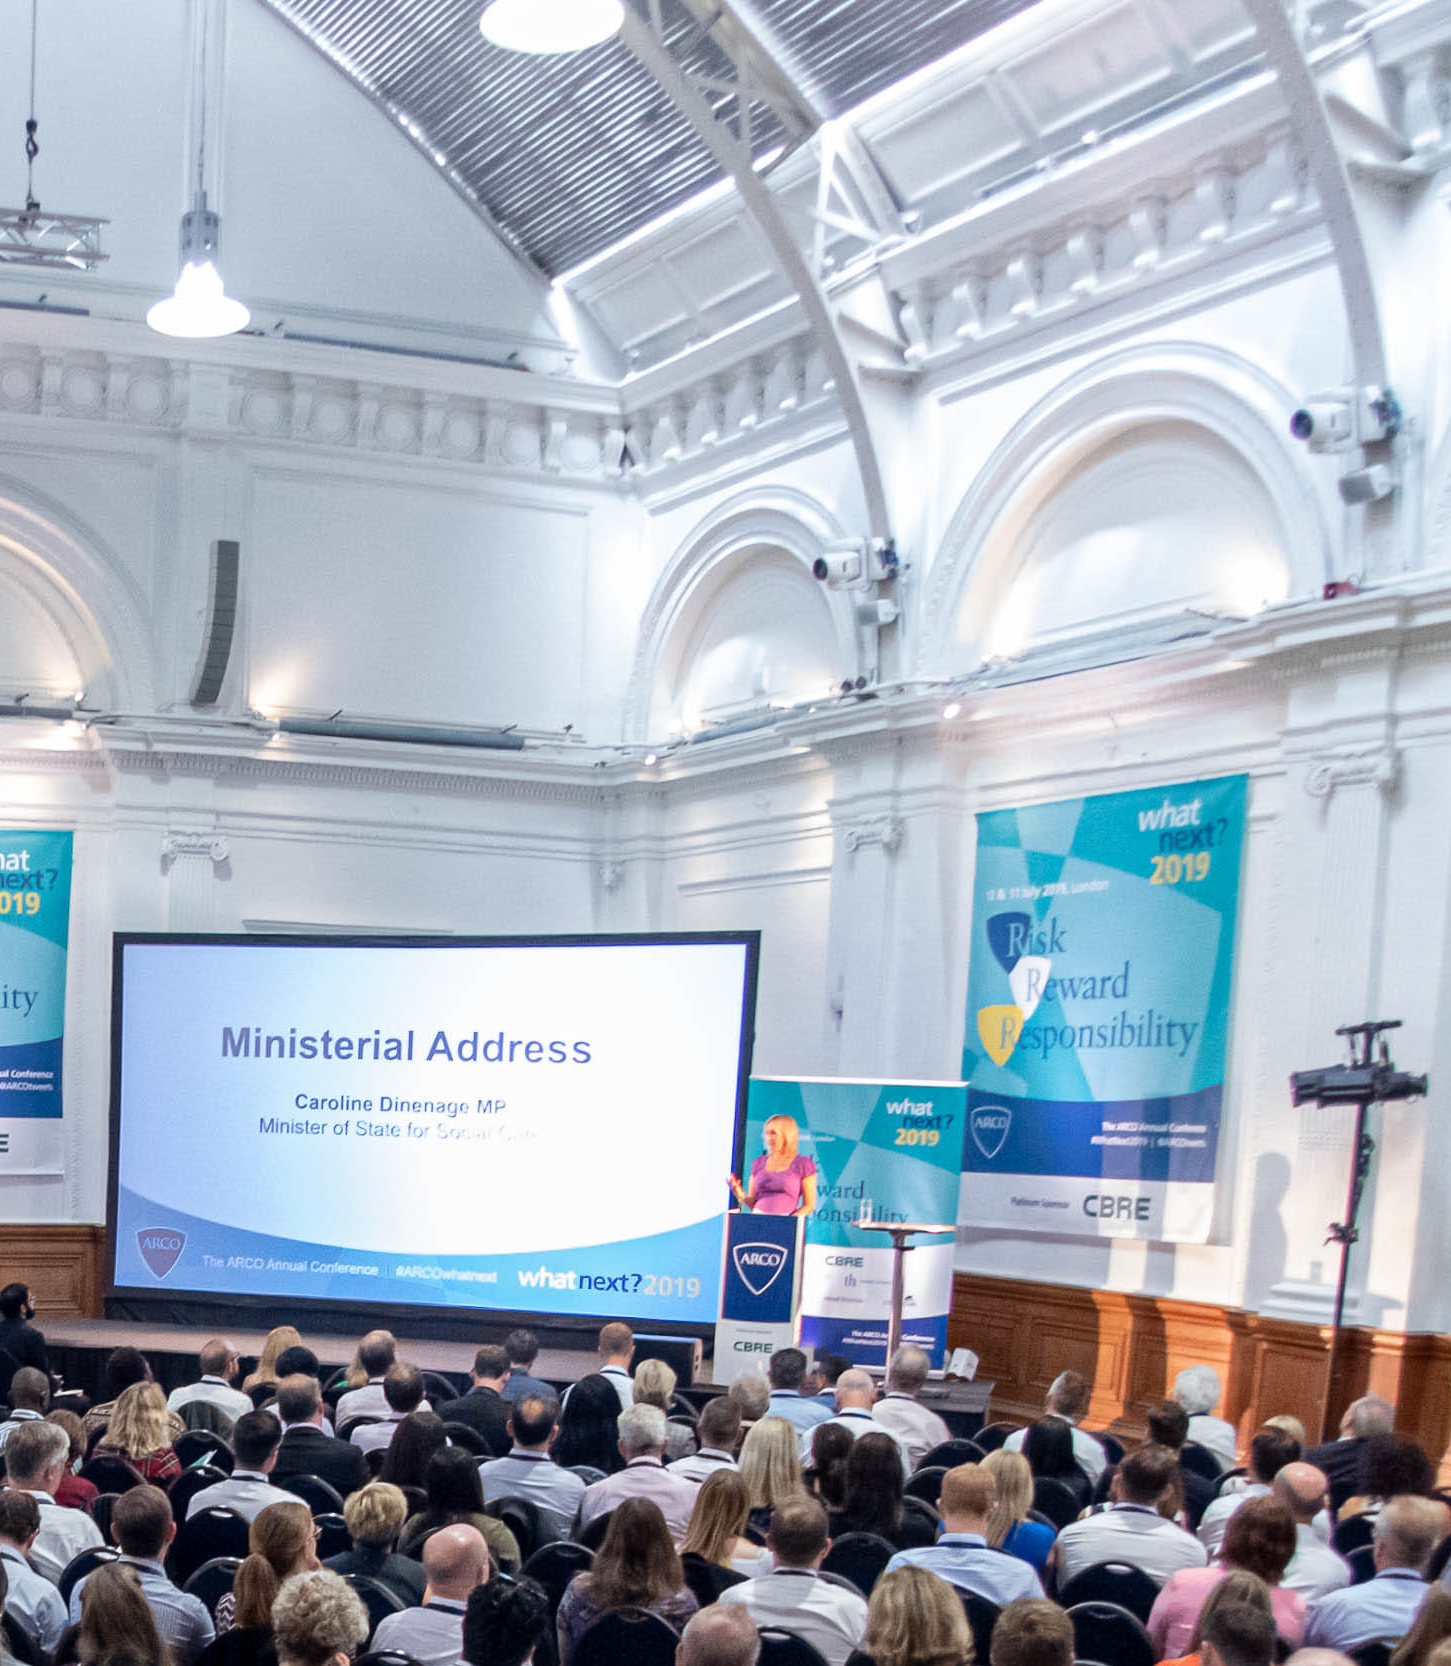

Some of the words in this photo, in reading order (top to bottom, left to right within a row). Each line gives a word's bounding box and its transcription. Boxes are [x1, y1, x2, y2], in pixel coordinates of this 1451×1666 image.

[1138, 799, 1201, 832] what
[1159, 818, 1228, 851] next?
[1149, 852, 1211, 885] 2019
[1006, 917, 1067, 957] Risk
[1025, 960, 1130, 1003] Reward
[998, 1009, 1199, 1059] Responsibility
[220, 1026, 414, 1061] Ministerial
[426, 1030, 592, 1064] Address
[11, 1069, 54, 1079] Conference
[294, 1093, 373, 1113] Caroline
[380, 1096, 470, 1118] Dinenage
[477, 1099, 506, 1115] MP
[886, 1098, 934, 1116] what
[259, 1117, 329, 1136] Minister
[333, 1119, 350, 1137] of
[355, 1121, 400, 1138] State
[407, 1122, 429, 1139] for
[903, 1115, 954, 1130] next?
[974, 1116, 1008, 1128] ARCO
[894, 1128, 941, 1146] 2019
[817, 1181, 864, 1199] ward
[1083, 1194, 1152, 1221] CBRE
[142, 1237, 181, 1251] ARCO
[203, 1255, 224, 1268] The
[227, 1257, 265, 1270] ARCO
[267, 1259, 307, 1272] Annual
[311, 1261, 379, 1276] Conference
[740, 1253, 780, 1267] ARCO
[825, 1256, 864, 1268] CBRE
[518, 1266, 577, 1291] what
[578, 1273, 643, 1294] next?
[643, 1275, 701, 1298] 2019
[733, 1341, 773, 1354] CBRE
